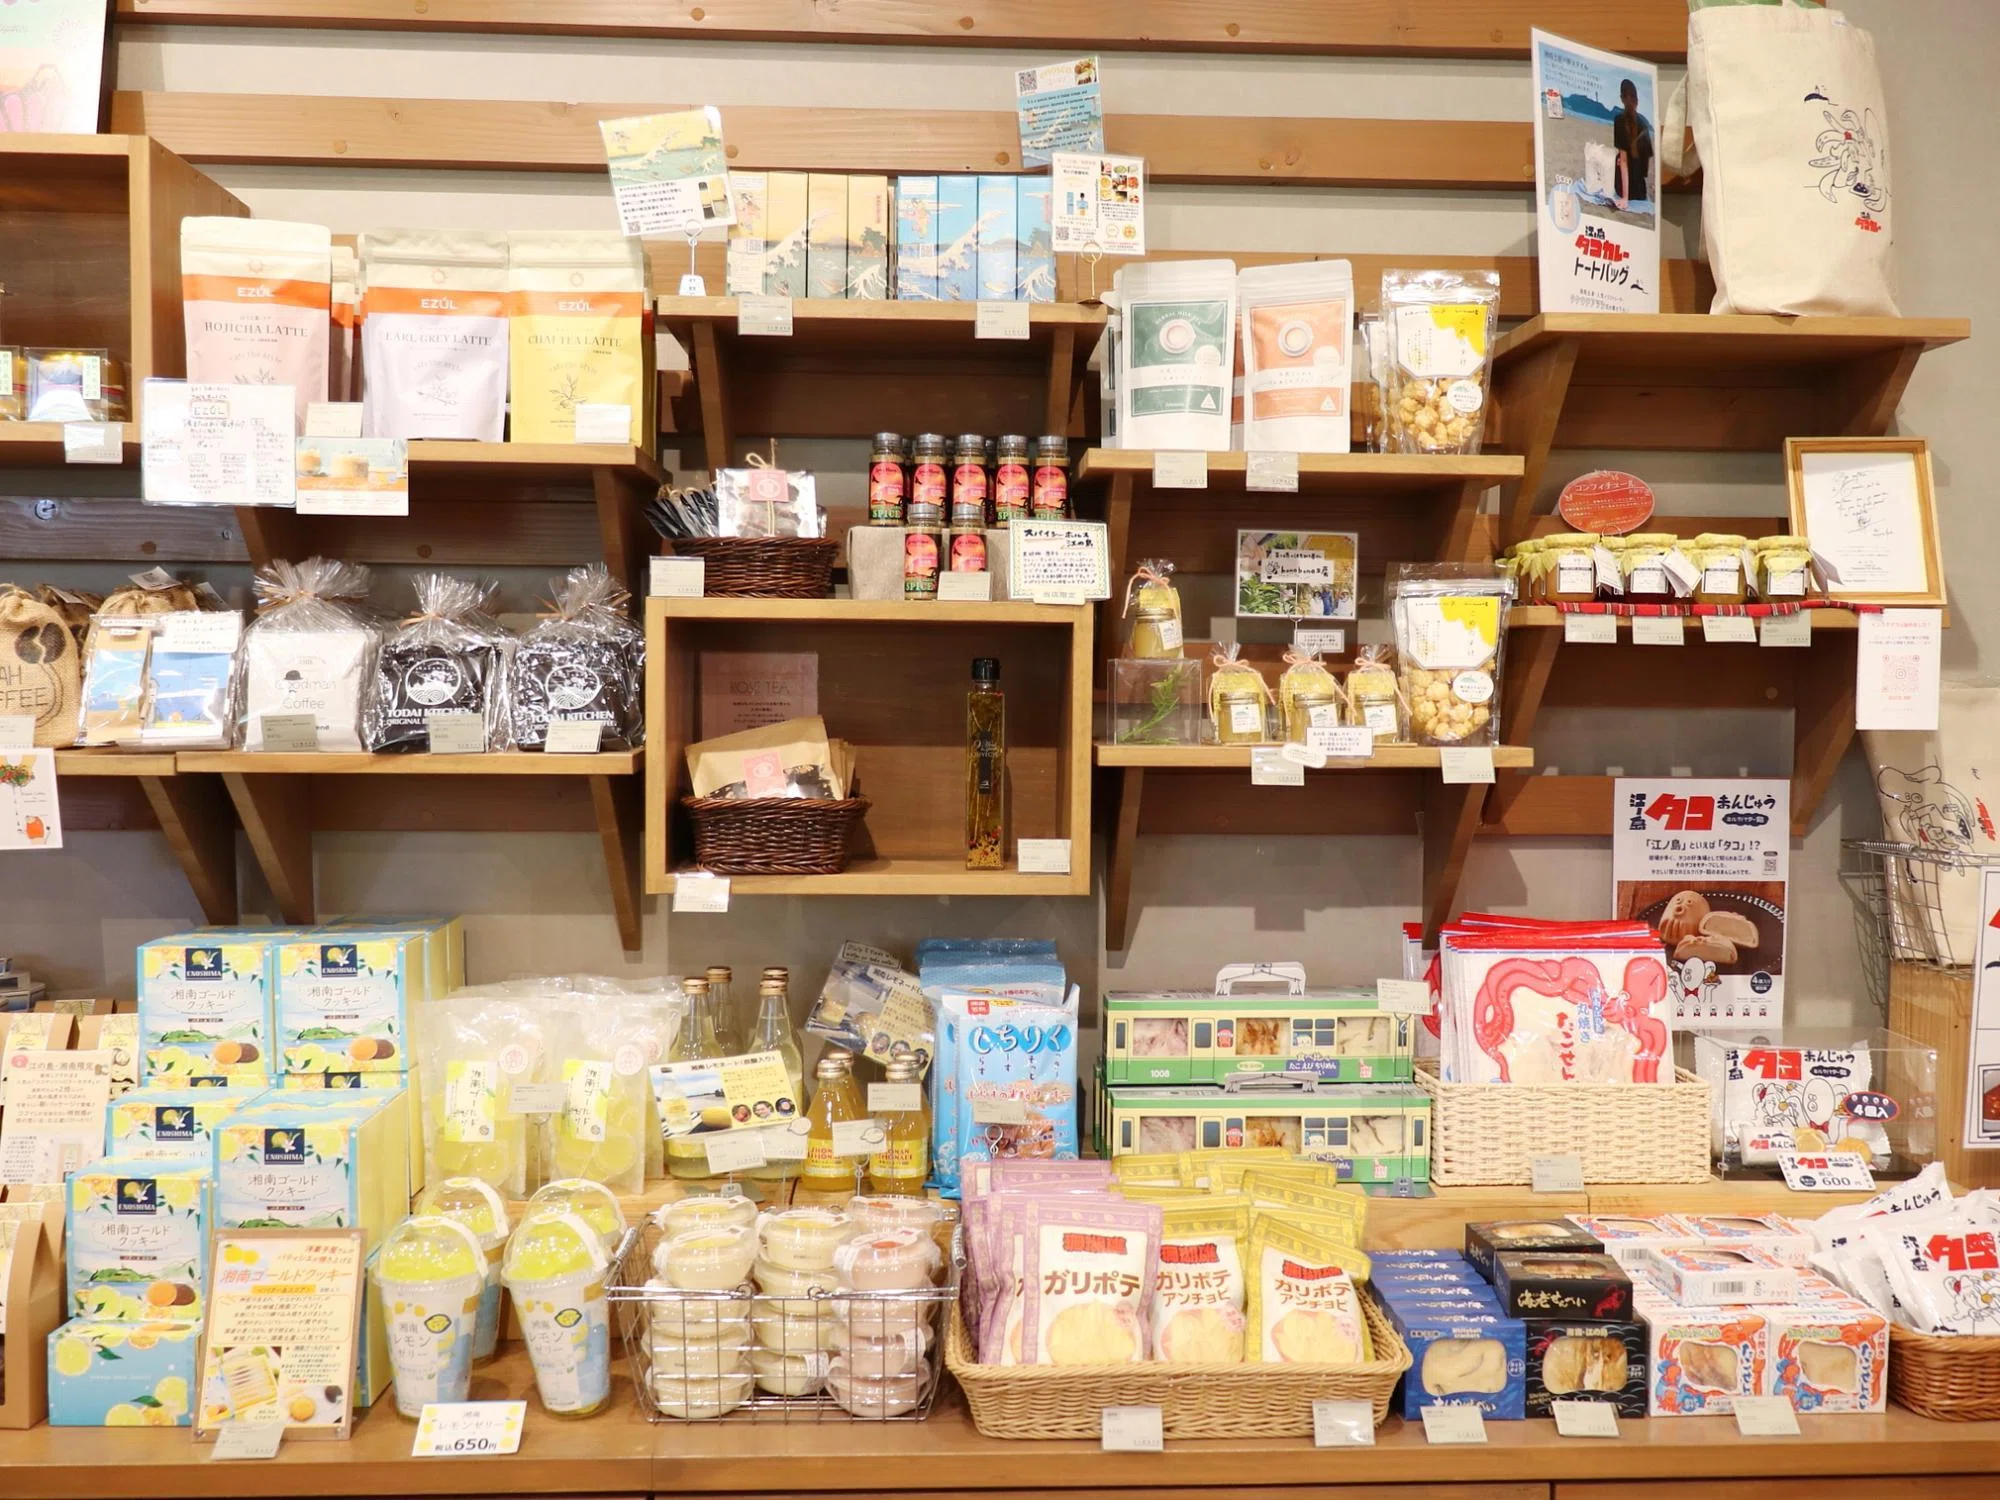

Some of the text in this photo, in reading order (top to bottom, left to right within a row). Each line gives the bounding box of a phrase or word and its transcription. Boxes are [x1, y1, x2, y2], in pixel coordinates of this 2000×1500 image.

[1575, 234, 1630, 262] タコカレー
[1574, 257, 1630, 285] トートバッグ
[420, 298, 458, 310] EZÚL
[557, 300, 594, 312] EZÚL
[205, 321, 308, 338] HOJICHA LATTE
[385, 332, 493, 346] EARL GREY LATTE
[528, 335, 623, 348] CHAI TEA LATTE
[872, 509, 900, 519] SPICE
[997, 510, 1025, 520] SPICE
[905, 581, 934, 592] SPICE
[765, 680, 790, 696] TEA
[283, 697, 325, 709] Coffee
[387, 708, 422, 718] TODAI
[567, 710, 615, 721] KITCHEN
[1644, 793, 1716, 830] タコ
[1717, 794, 1776, 810] まんじゅう
[322, 967, 357, 975] ENOSHIMA
[171, 989, 236, 1001] 湘南ゴールド
[307, 986, 371, 998] 湘南ゴールド
[186, 1000, 225, 1010] クッキー
[323, 997, 360, 1007] クッキー
[1288, 1061, 1337, 1070] たこ えび ちりめん
[1743, 1049, 1801, 1080] タコ
[1804, 1049, 1855, 1063] まんじゅう
[1150, 1069, 1170, 1078] 1008
[1853, 1104, 1889, 1119] 4個入
[156, 1130, 194, 1138] ENOSHIMA
[265, 1153, 304, 1161] ENOSHIMA
[1798, 1157, 1828, 1169] タコ
[248, 1175, 319, 1186] 湘南ゴールド
[265, 1187, 306, 1197] クッキー
[118, 1203, 157, 1211] ENOSHIMA
[101, 1225, 171, 1236] 湘南ゴールド
[119, 1236, 158, 1246] クッキー
[1923, 1232, 2000, 1271] タコ
[221, 1268, 352, 1284] 湘南ゴールドクッキー
[1156, 1269, 1231, 1291] ガリポテ
[1044, 1270, 1140, 1297] ガリポテ
[1275, 1279, 1351, 1298] ガリポテ
[1163, 1288, 1231, 1307] アンチョビ
[1280, 1293, 1348, 1312] アンチョビ
[1517, 1288, 1586, 1309] 海老せんべい
[394, 1335, 432, 1348] レモン
[528, 1331, 566, 1344] レモン
[398, 1350, 428, 1359] ゼリー
[534, 1346, 564, 1355] ゼリー
[438, 1421, 504, 1430] レモンゼリー
